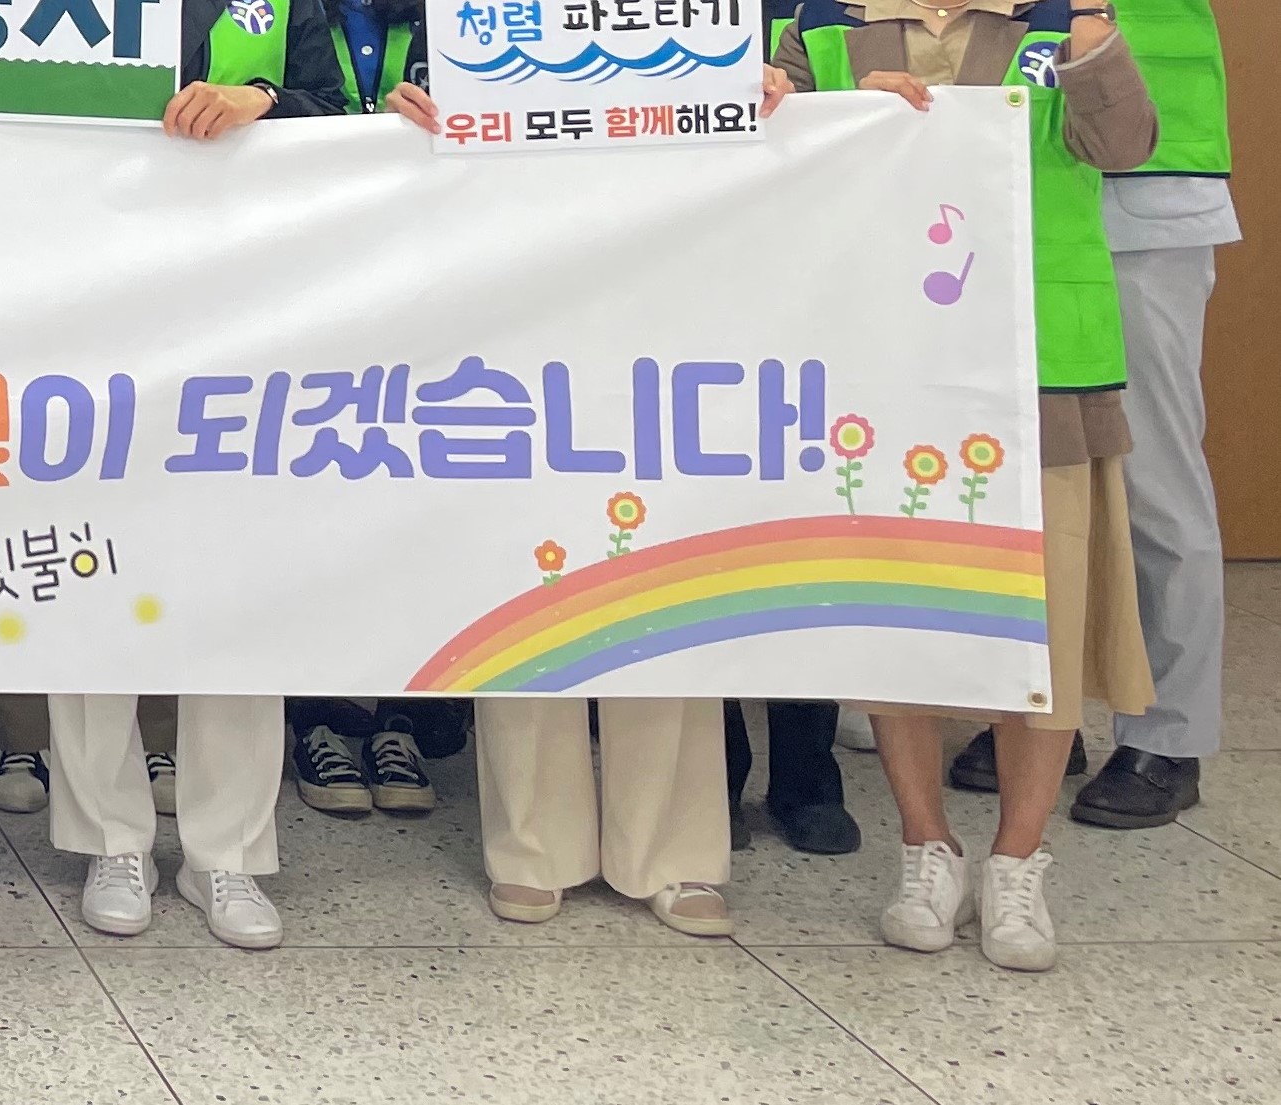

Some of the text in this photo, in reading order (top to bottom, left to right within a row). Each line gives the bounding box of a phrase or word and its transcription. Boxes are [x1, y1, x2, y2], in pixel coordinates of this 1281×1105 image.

[457, 0, 543, 46] 청렴
[446, 102, 757, 143] 우리 모두 함께해요!
[166, 356, 826, 479] 되겠습니다!
